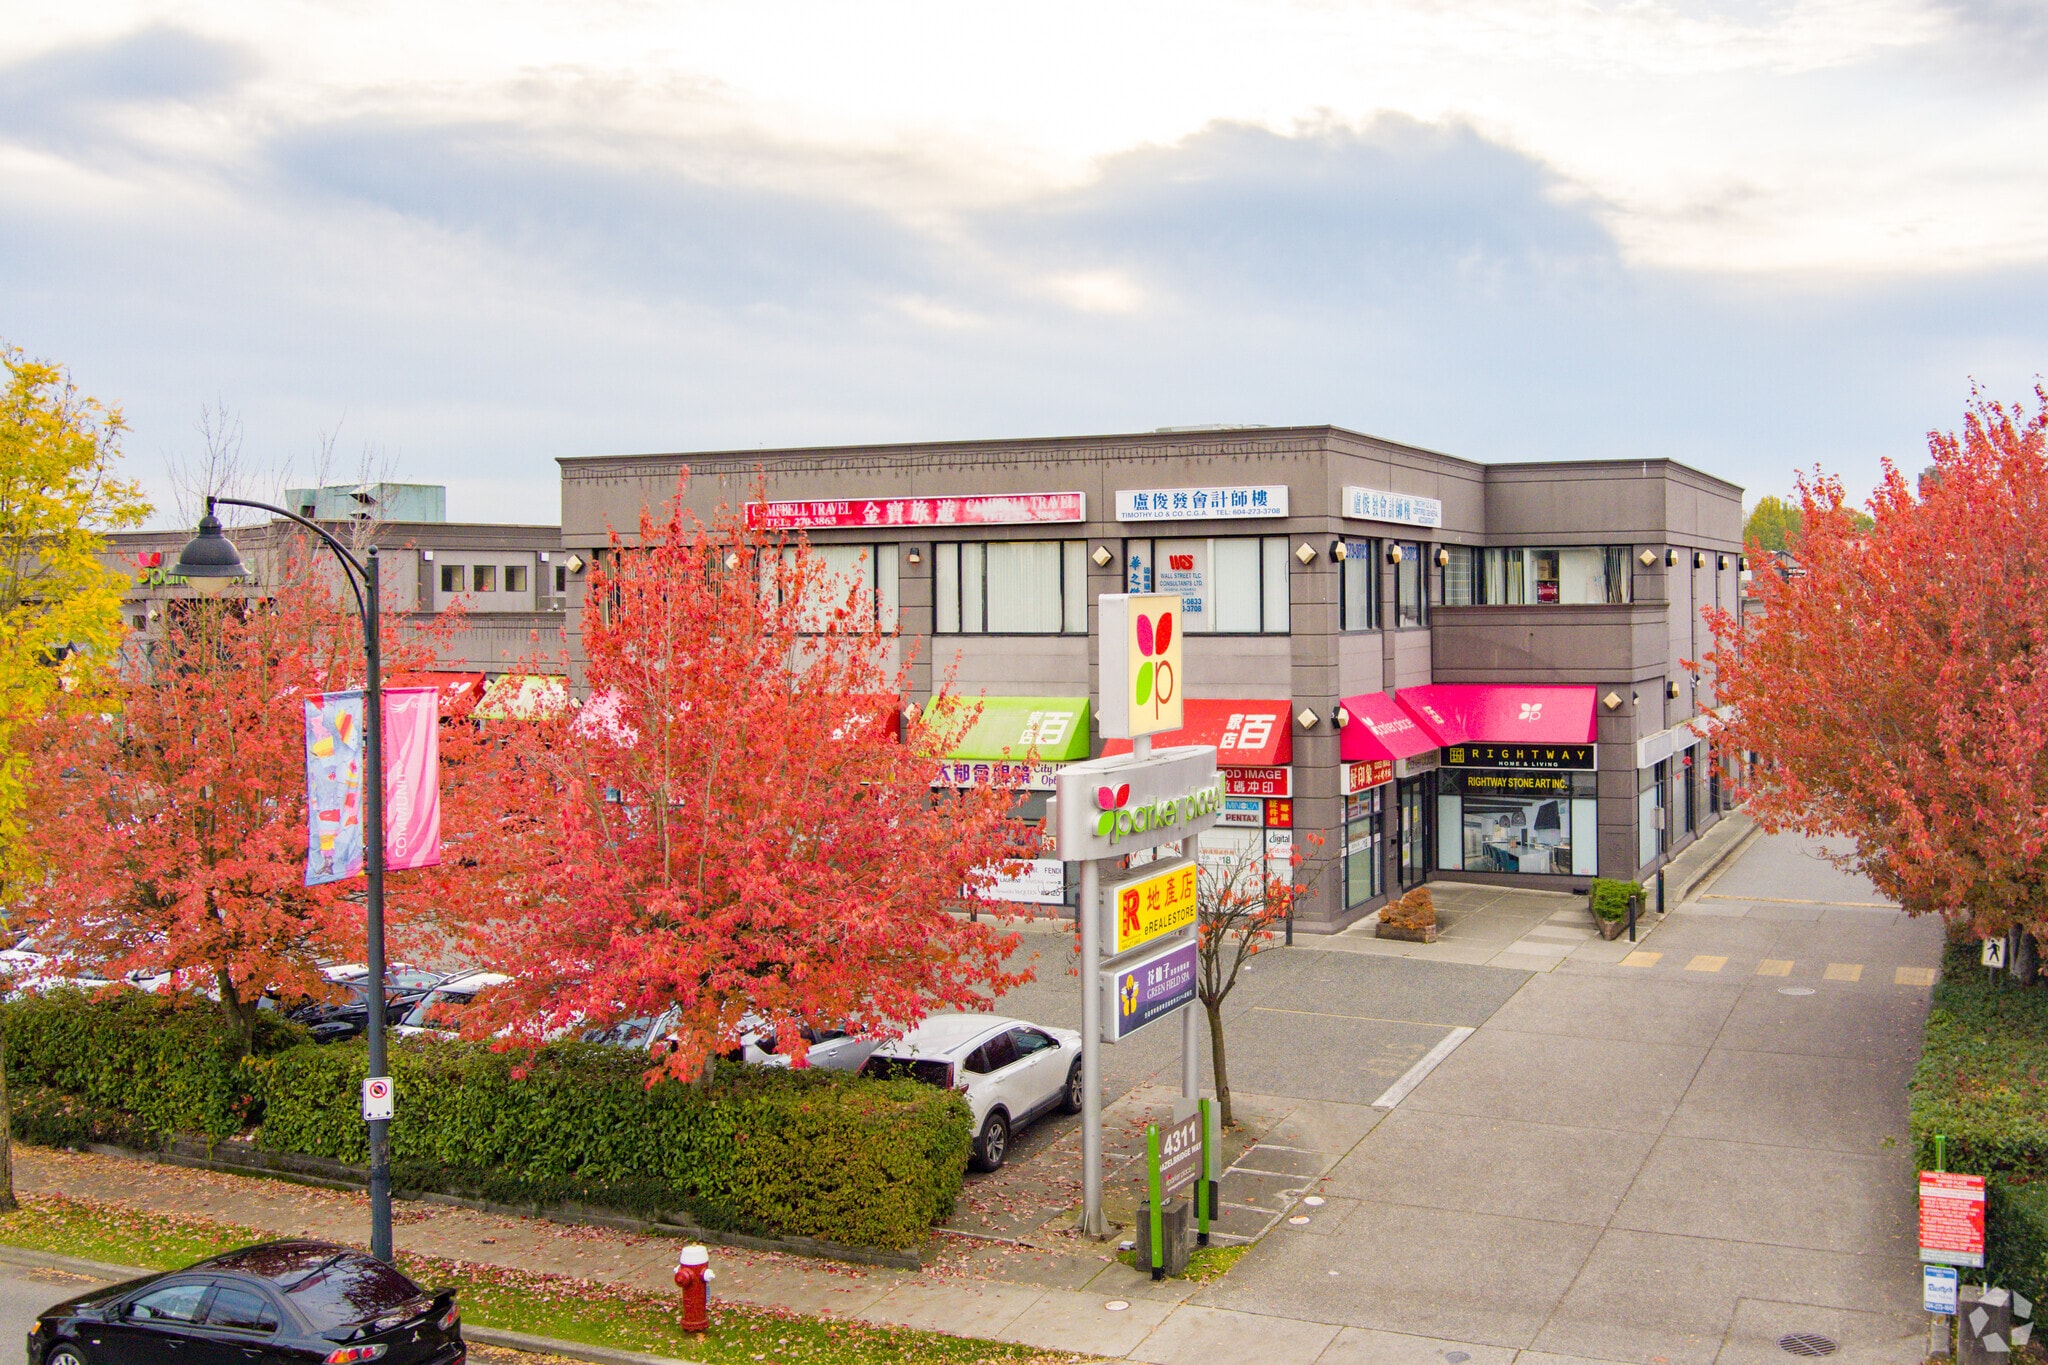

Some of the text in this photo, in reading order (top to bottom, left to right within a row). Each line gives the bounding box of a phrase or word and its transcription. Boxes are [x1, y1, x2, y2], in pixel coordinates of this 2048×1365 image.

[1029, 495, 1077, 510] TRAVEL
[1133, 489, 1268, 511] 盧俊發會計師樓
[752, 501, 853, 517] CMPBELL TRAVEL
[794, 516, 837, 526] 270-3863
[1223, 769, 1282, 780] OD IMAGE
[1467, 776, 1569, 789] RIGHTWAY STONE ART INC.
[395, 758, 408, 858] COMMUNITY
[1225, 801, 1259, 810] MINOLTA
[1115, 797, 1180, 845] parker
[1185, 786, 1219, 828] place
[1225, 813, 1258, 823] PENTAX
[1269, 831, 1290, 845] digital
[1147, 871, 1193, 912] 地產店
[1123, 889, 1141, 937] R
[1144, 904, 1194, 936] eREALESTORE
[1147, 971, 1190, 1000] GREEN FIELD SPA
[1164, 1121, 1196, 1156] 4311
[1191, 1141, 1202, 1154] WAY
